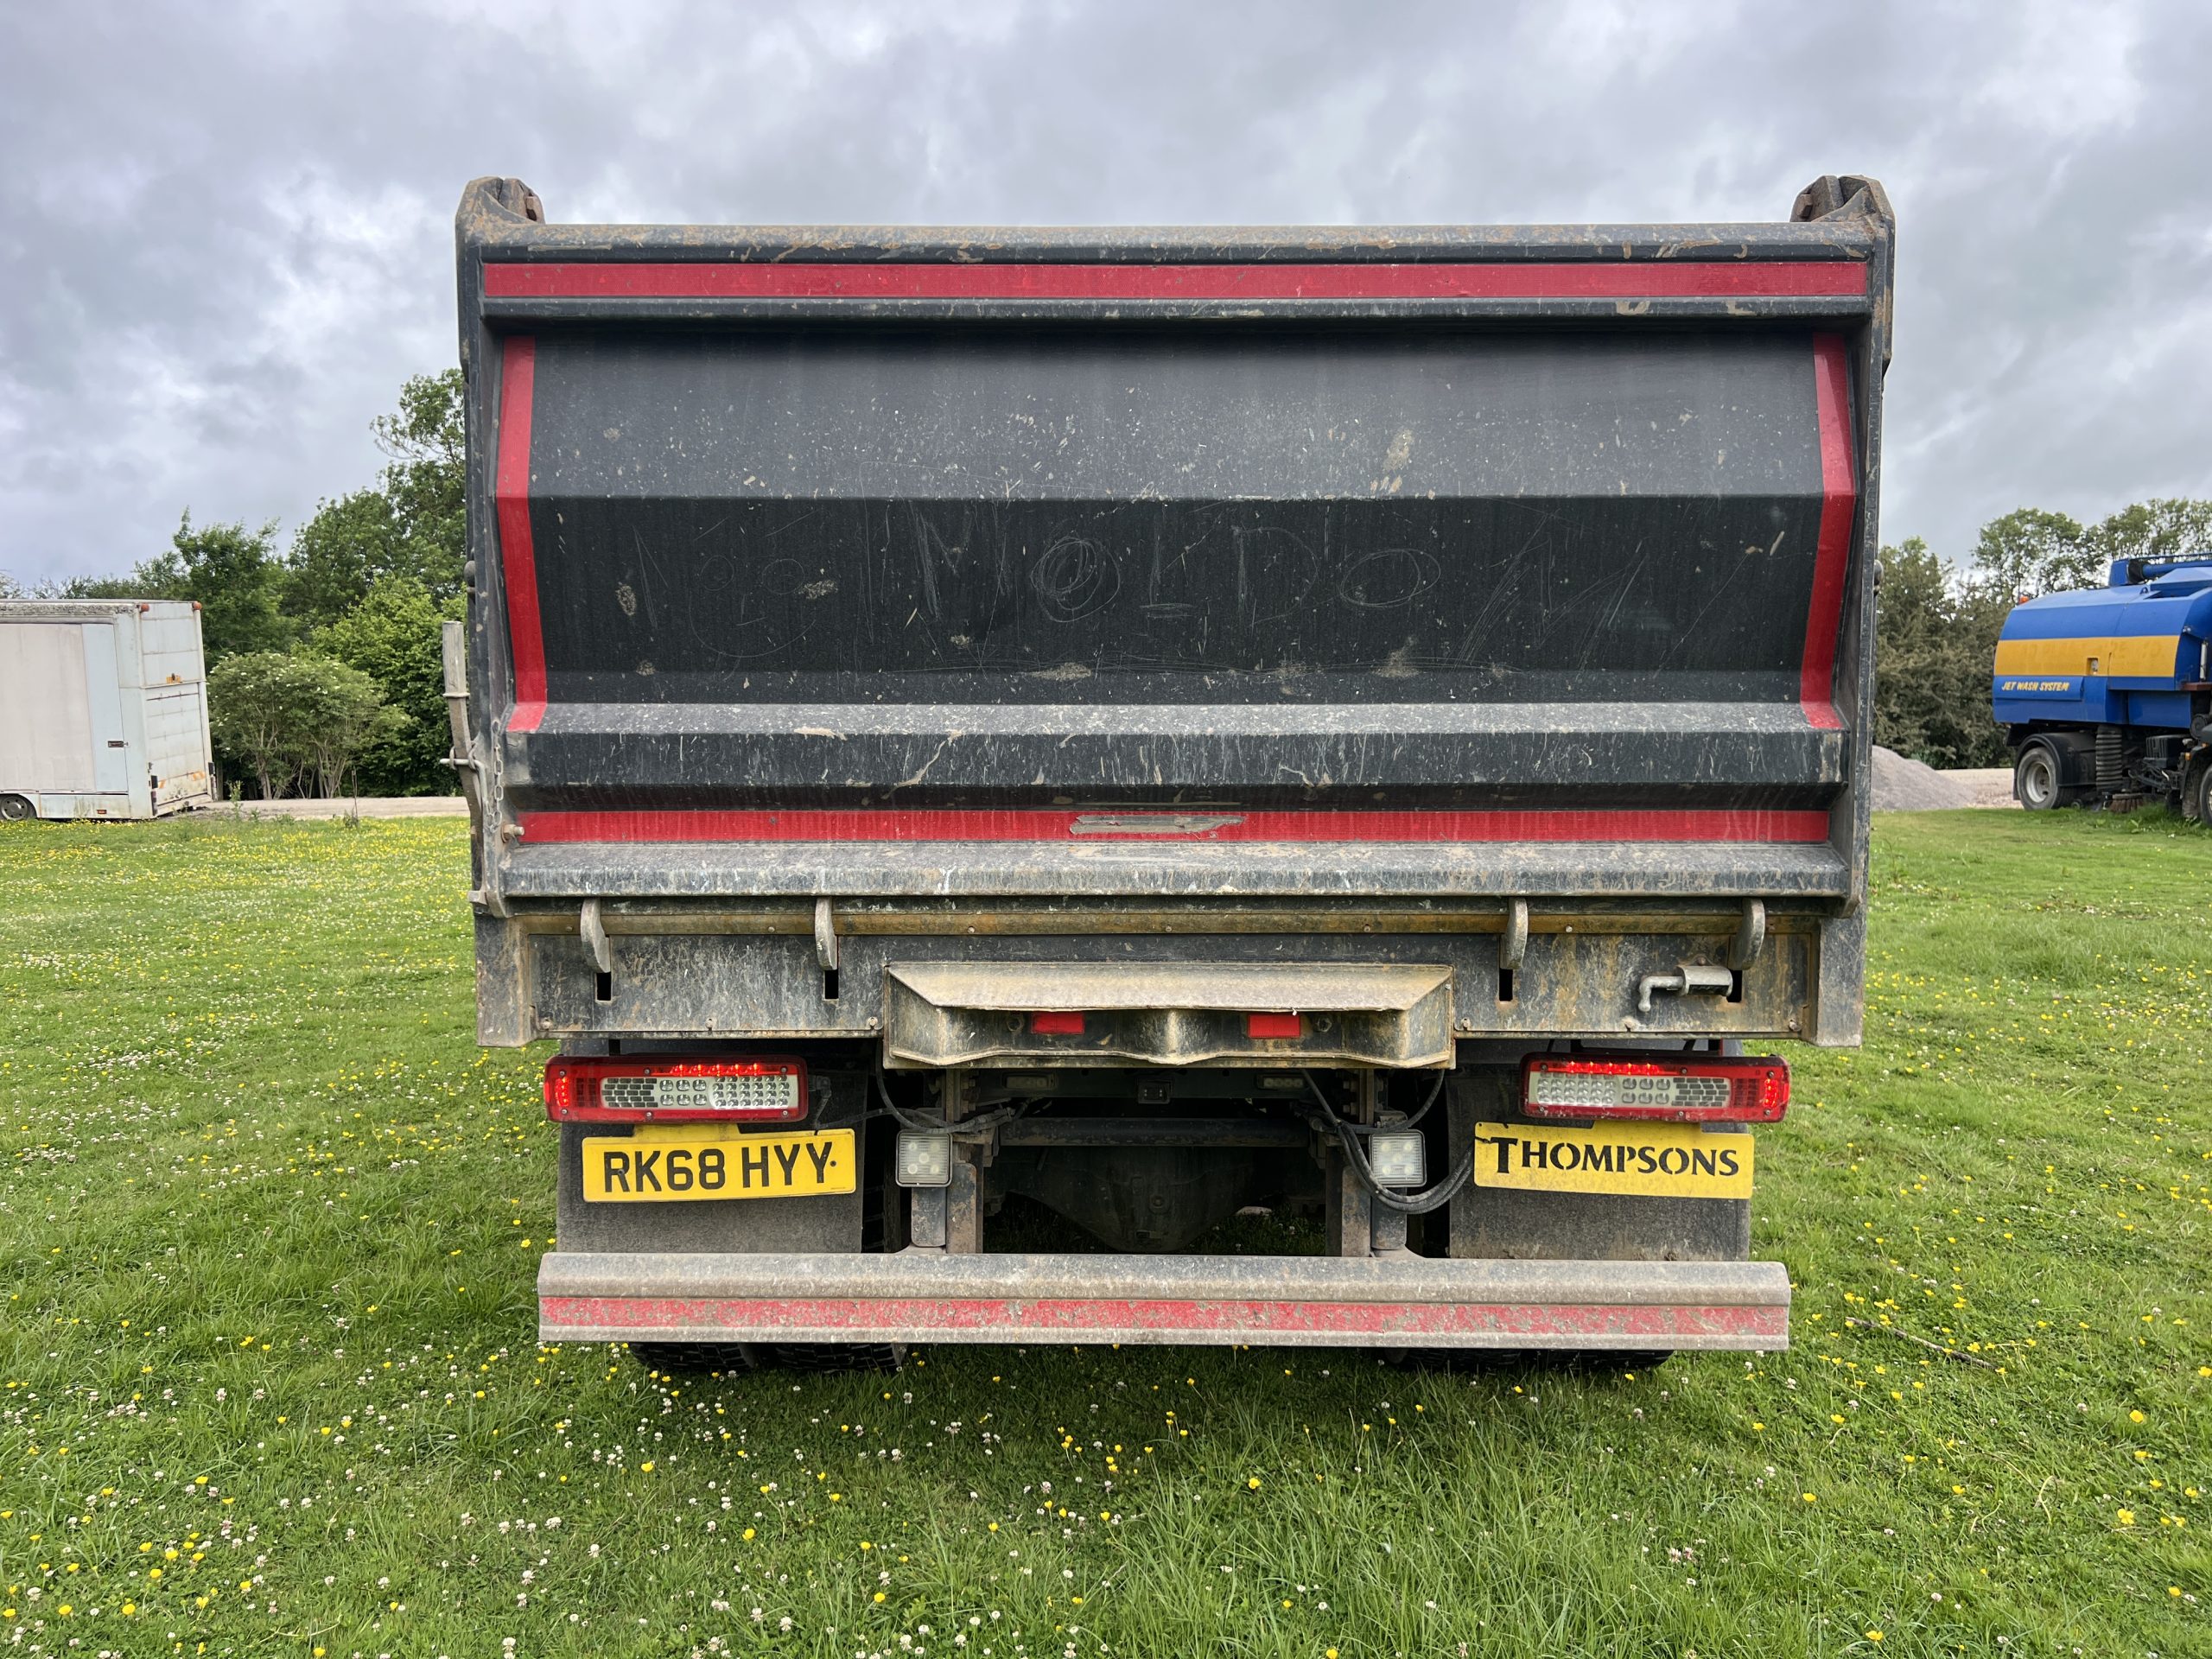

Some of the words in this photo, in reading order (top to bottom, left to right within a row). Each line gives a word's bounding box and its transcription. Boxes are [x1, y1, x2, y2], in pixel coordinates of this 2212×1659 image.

[2001, 681, 2017, 690] JET
[2017, 681, 2039, 691] WASH
[2039, 682, 2070, 691] SYSTEM
[603, 1148, 726, 1193] RK68
[741, 1141, 833, 1189] HYY
[1490, 1136, 1740, 1177] THOMPSONS
